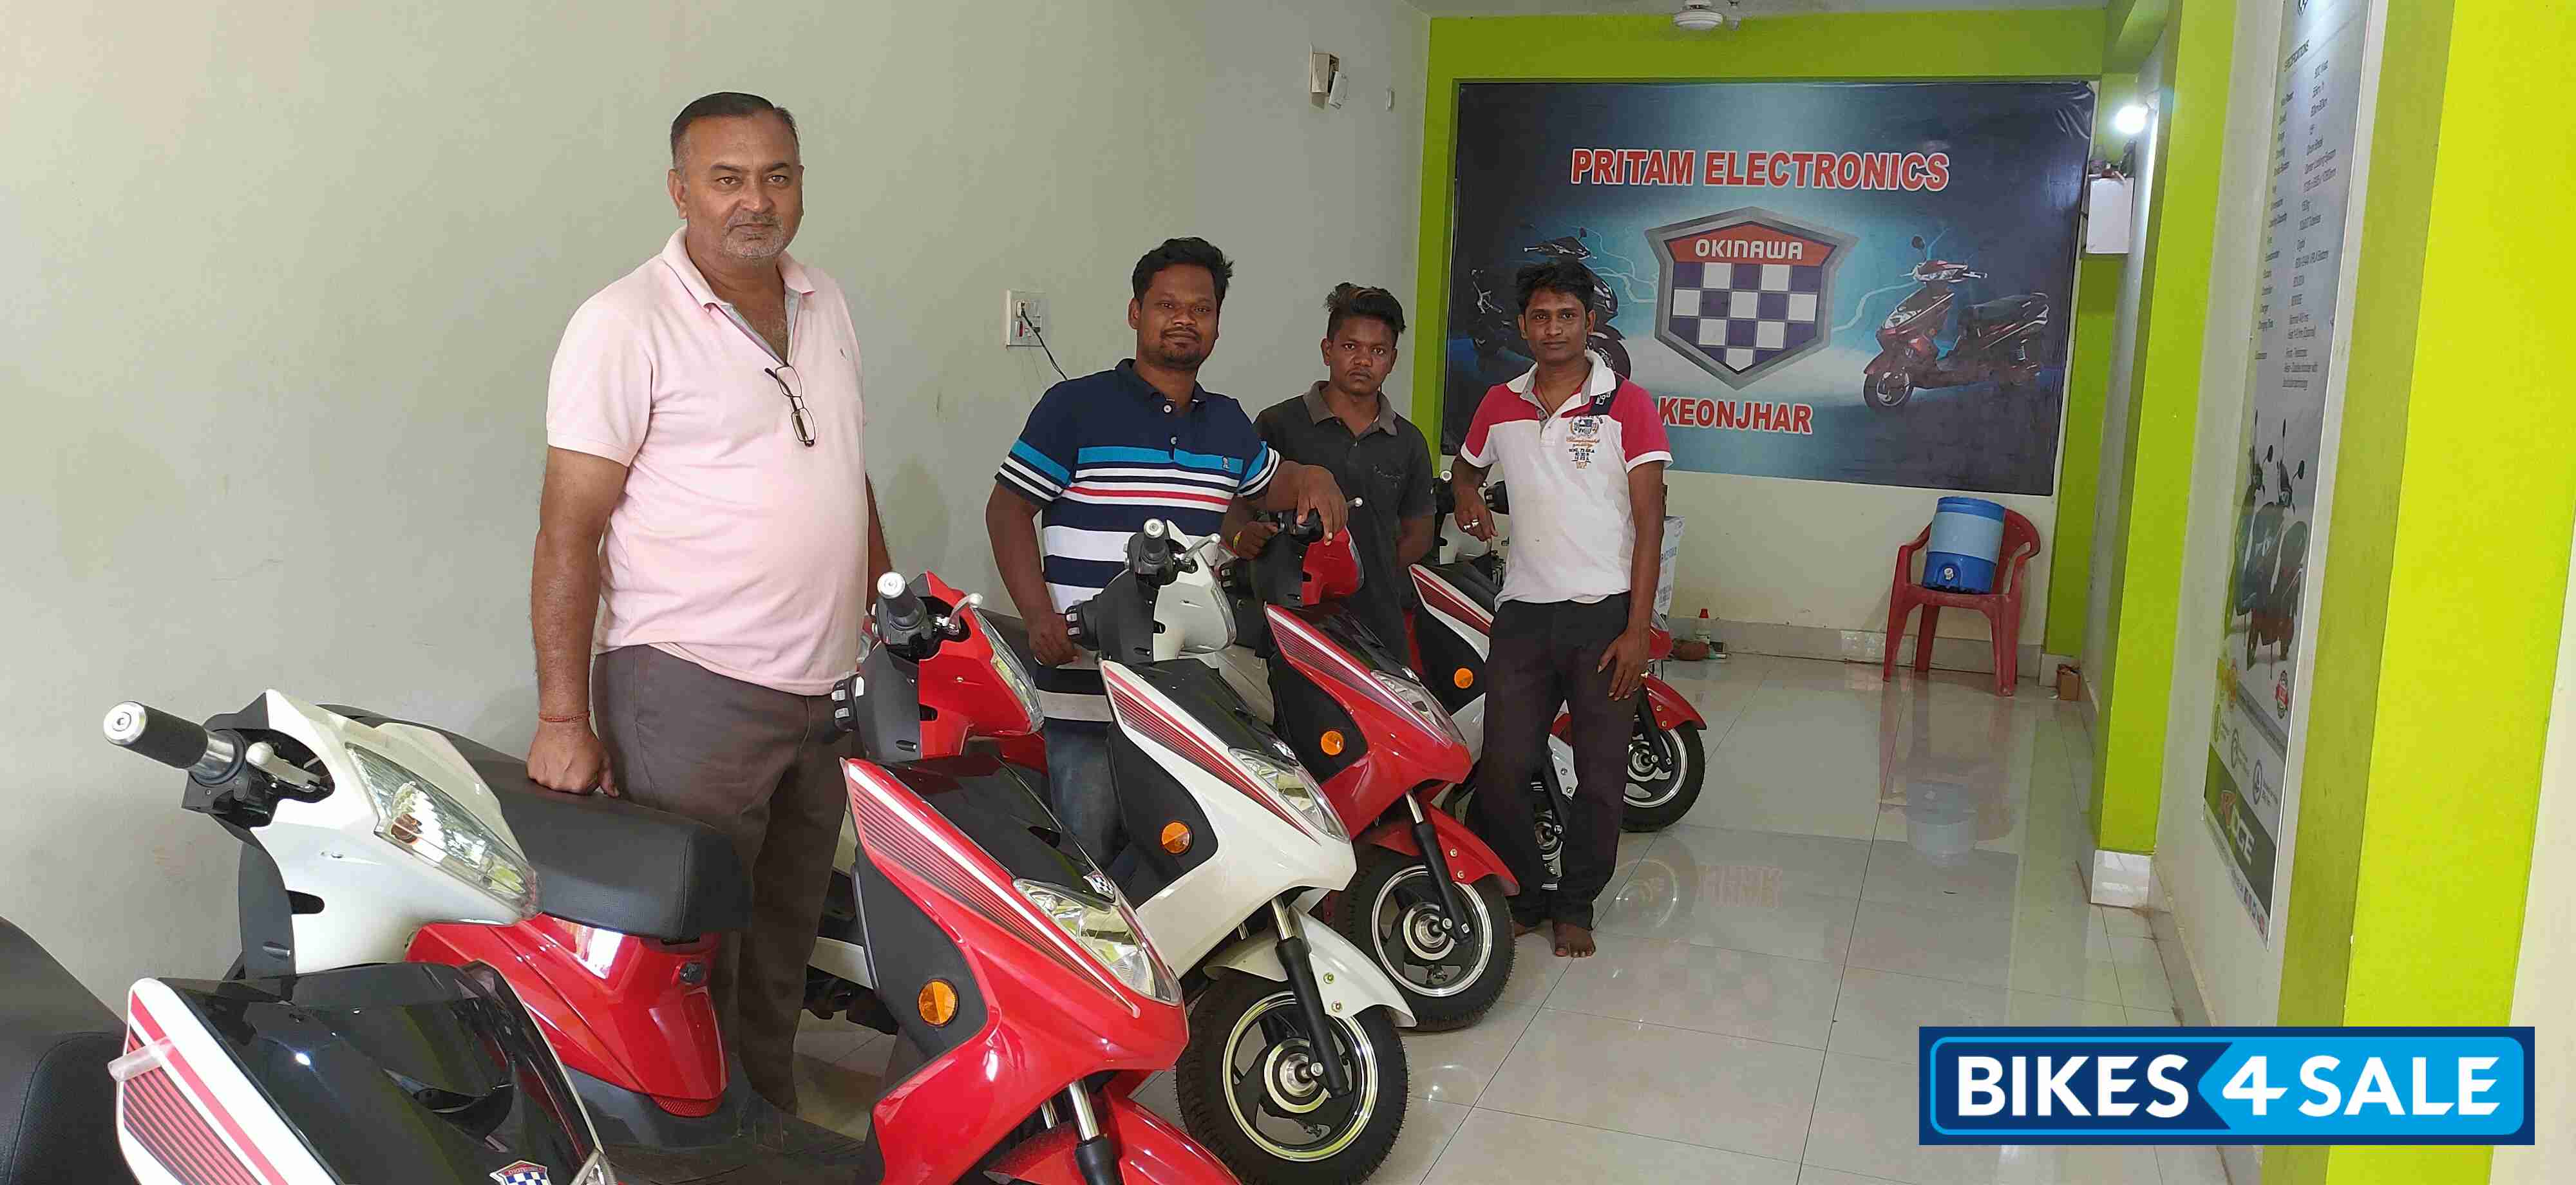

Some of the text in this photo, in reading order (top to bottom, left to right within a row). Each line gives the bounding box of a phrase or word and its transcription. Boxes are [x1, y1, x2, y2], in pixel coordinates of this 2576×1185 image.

[1571, 149, 1949, 191] PRITAM ELECTRONICS
[1695, 239, 1803, 261] OKINAWA
[1658, 396, 1813, 434] KEONJHAR
